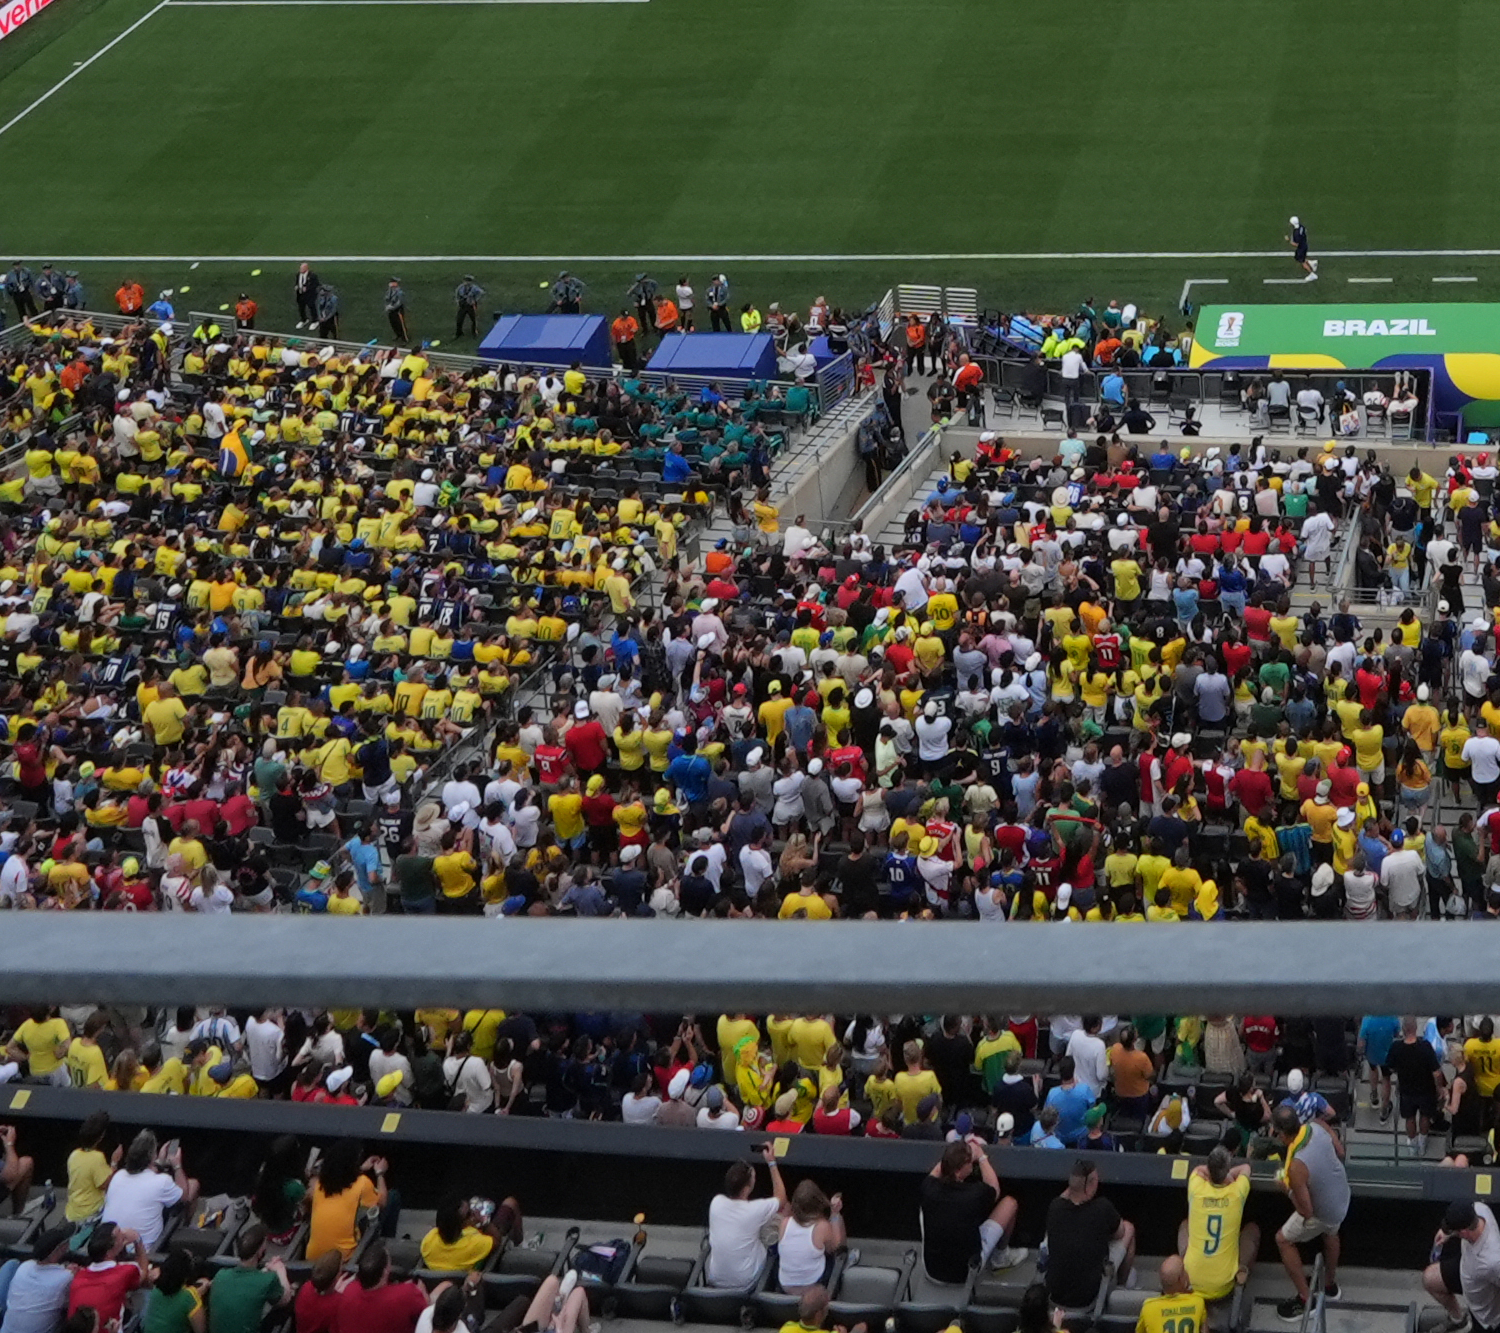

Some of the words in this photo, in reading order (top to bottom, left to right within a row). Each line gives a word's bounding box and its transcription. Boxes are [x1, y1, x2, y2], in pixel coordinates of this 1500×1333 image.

[1323, 318, 1437, 337] BRAZIL
[155, 611, 170, 629] 15
[888, 866, 905, 882] 10
[1203, 1214, 1222, 1256] 9
